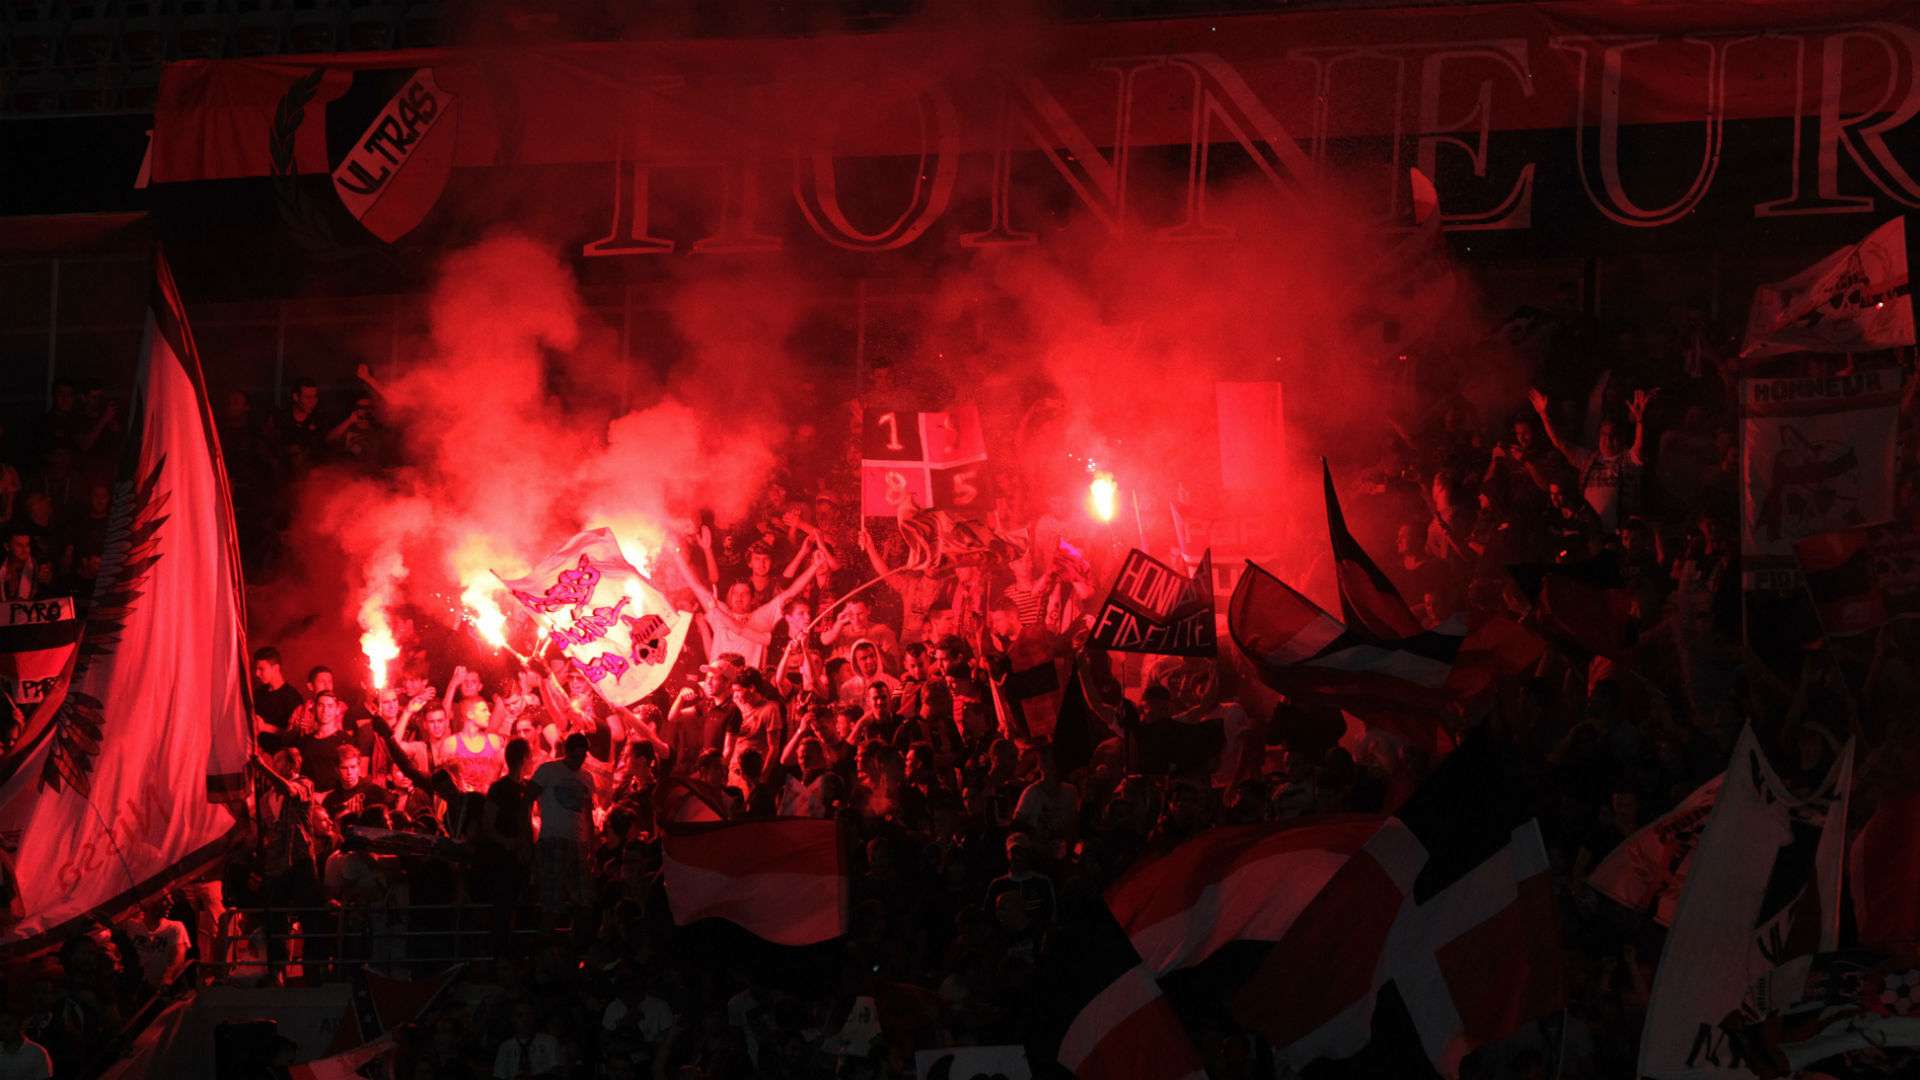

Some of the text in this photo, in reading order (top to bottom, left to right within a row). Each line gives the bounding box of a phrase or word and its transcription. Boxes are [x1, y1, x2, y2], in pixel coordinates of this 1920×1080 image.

[336, 80, 438, 195] ULTRAS
[878, 411, 904, 450] 1
[952, 471, 978, 506] 5
[9, 601, 61, 625] PYRO
